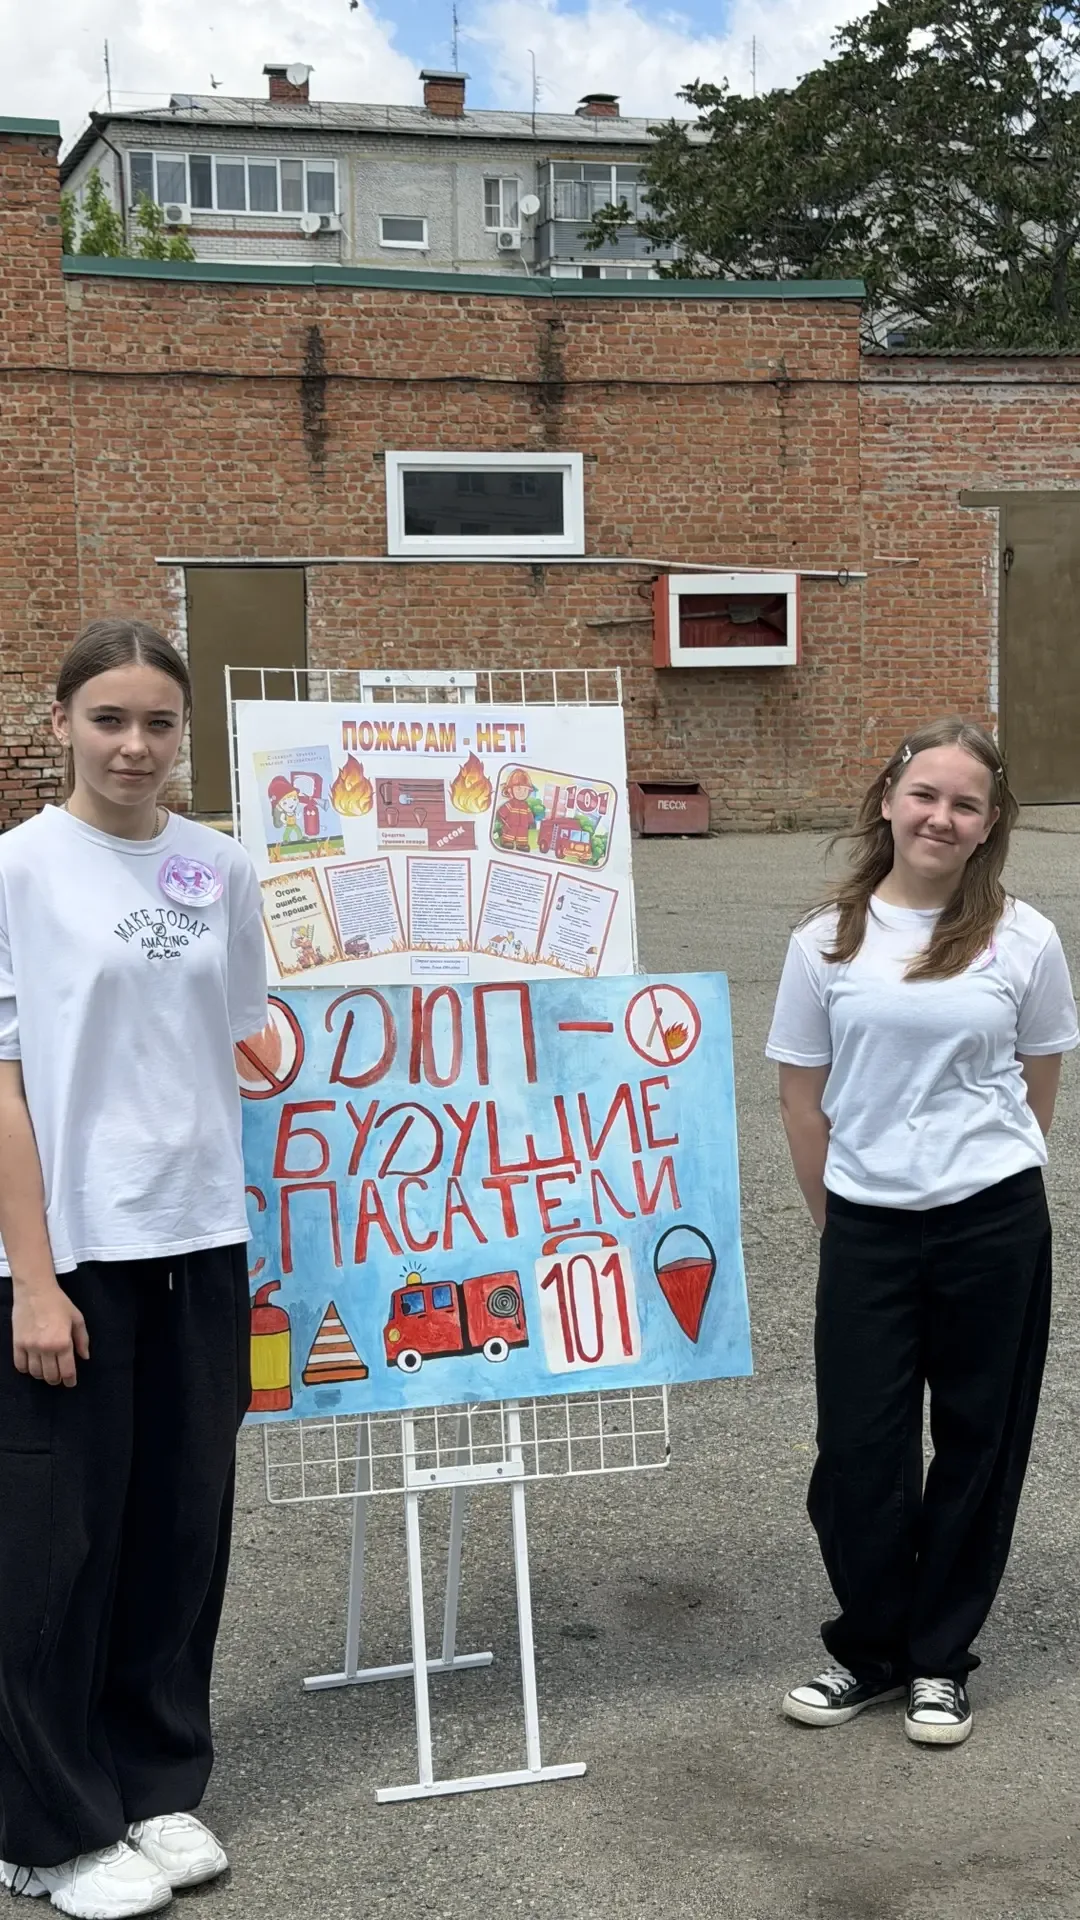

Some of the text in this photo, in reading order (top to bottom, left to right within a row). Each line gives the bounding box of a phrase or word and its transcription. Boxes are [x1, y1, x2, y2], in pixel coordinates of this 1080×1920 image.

[341, 720, 457, 752] ПОЖАРАМ
[475, 722, 527, 753] НЕТ!
[565, 785, 610, 816] 101
[657, 799, 687, 810] ПЕСОК
[275, 887, 301, 898] Огонь
[275, 894, 308, 909] ошибок
[114, 907, 211, 943] MAKE TODAY
[270, 912, 281, 921] не
[282, 902, 318, 917] прощает
[141, 935, 189, 949] AMAZING
[325, 982, 537, 1088] ДЮП
[272, 1075, 680, 1180] БУДУЩИЕ
[541, 1253, 633, 1364] 101
